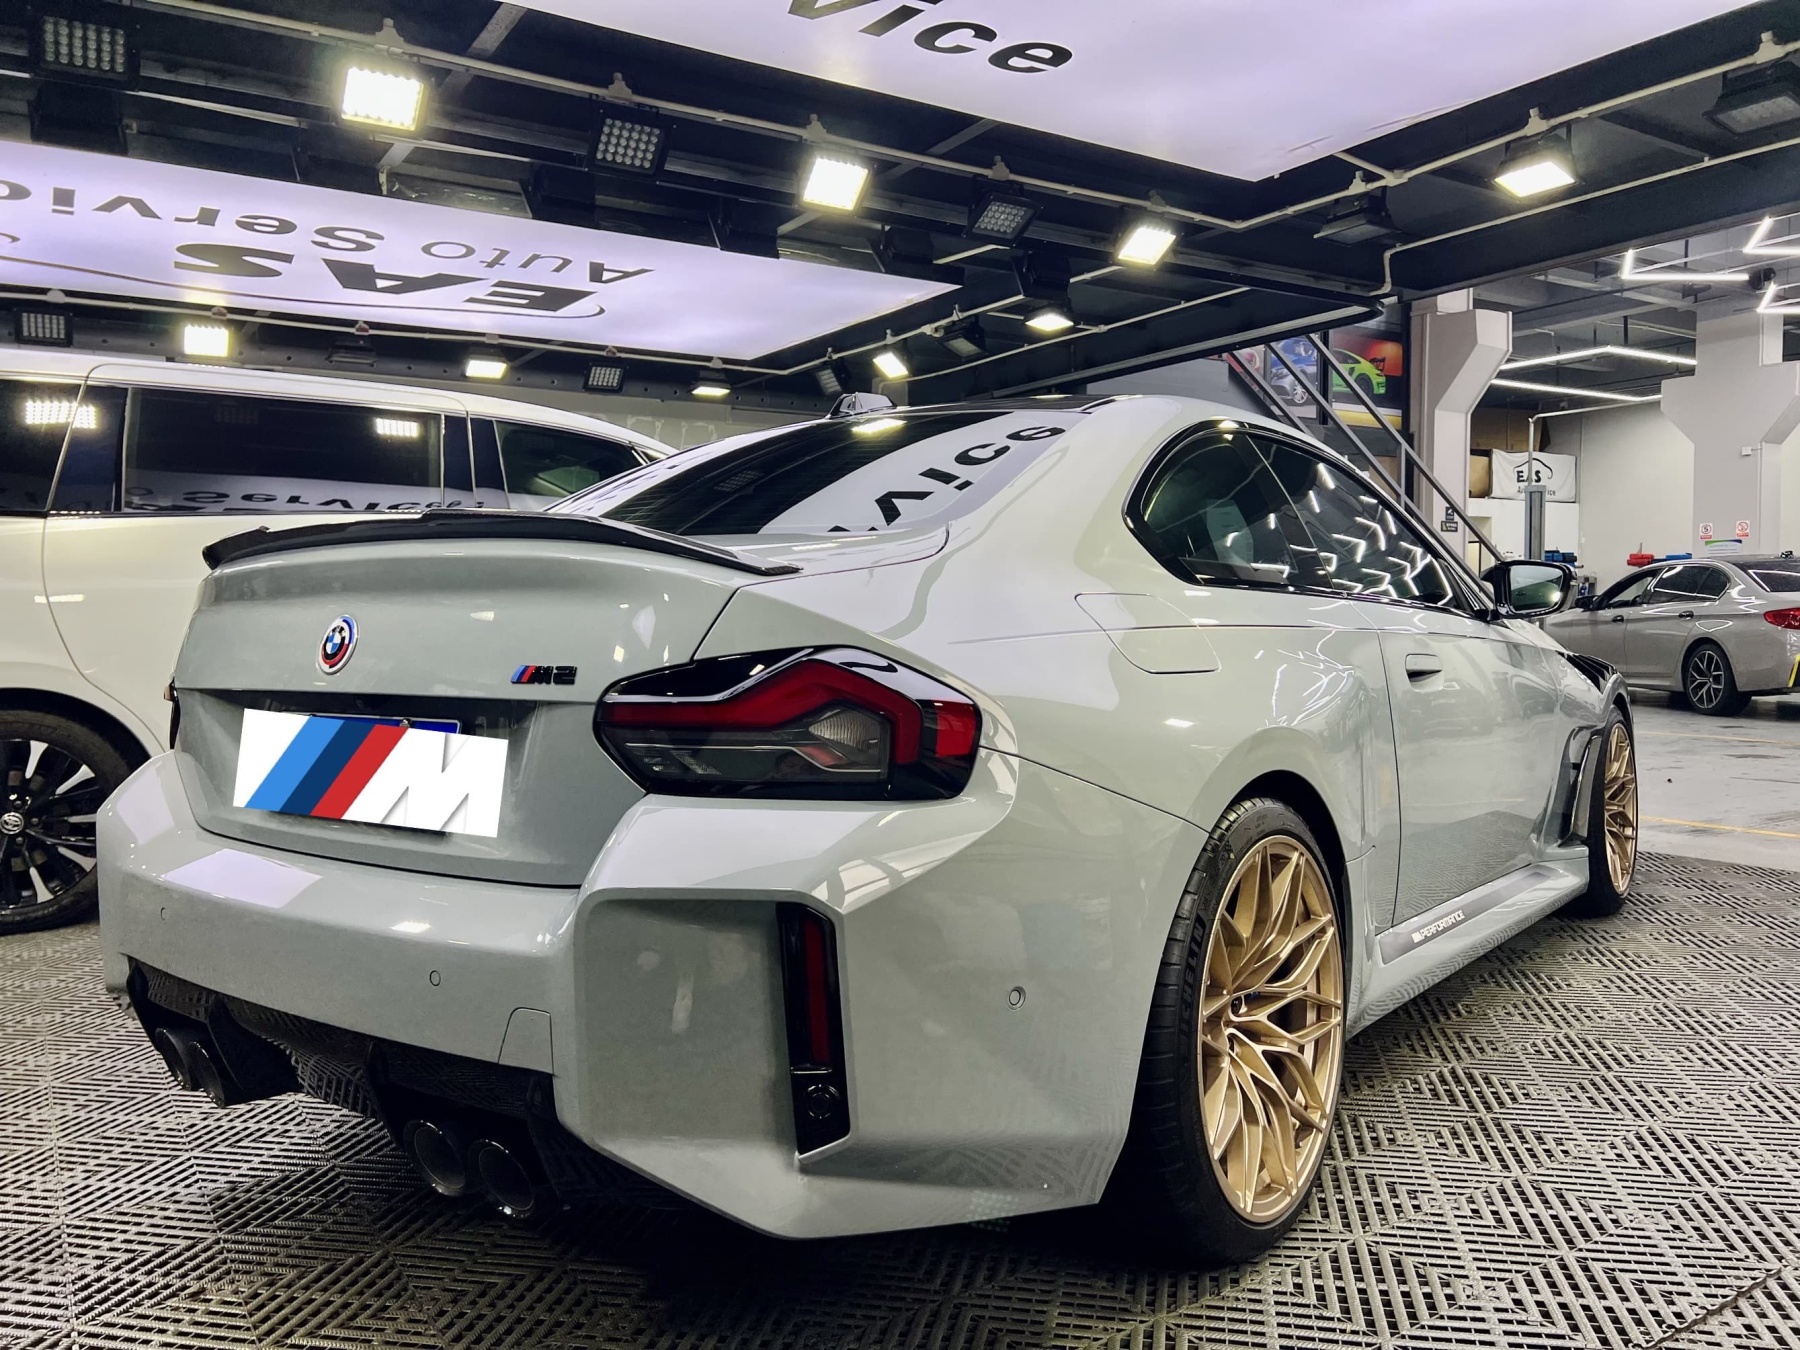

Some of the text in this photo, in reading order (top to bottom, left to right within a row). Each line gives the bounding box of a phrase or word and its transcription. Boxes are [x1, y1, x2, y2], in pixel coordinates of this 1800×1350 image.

[174, 243, 598, 312] EAS
[421, 241, 655, 284] Auto
[1516, 469, 1542, 483] ES
